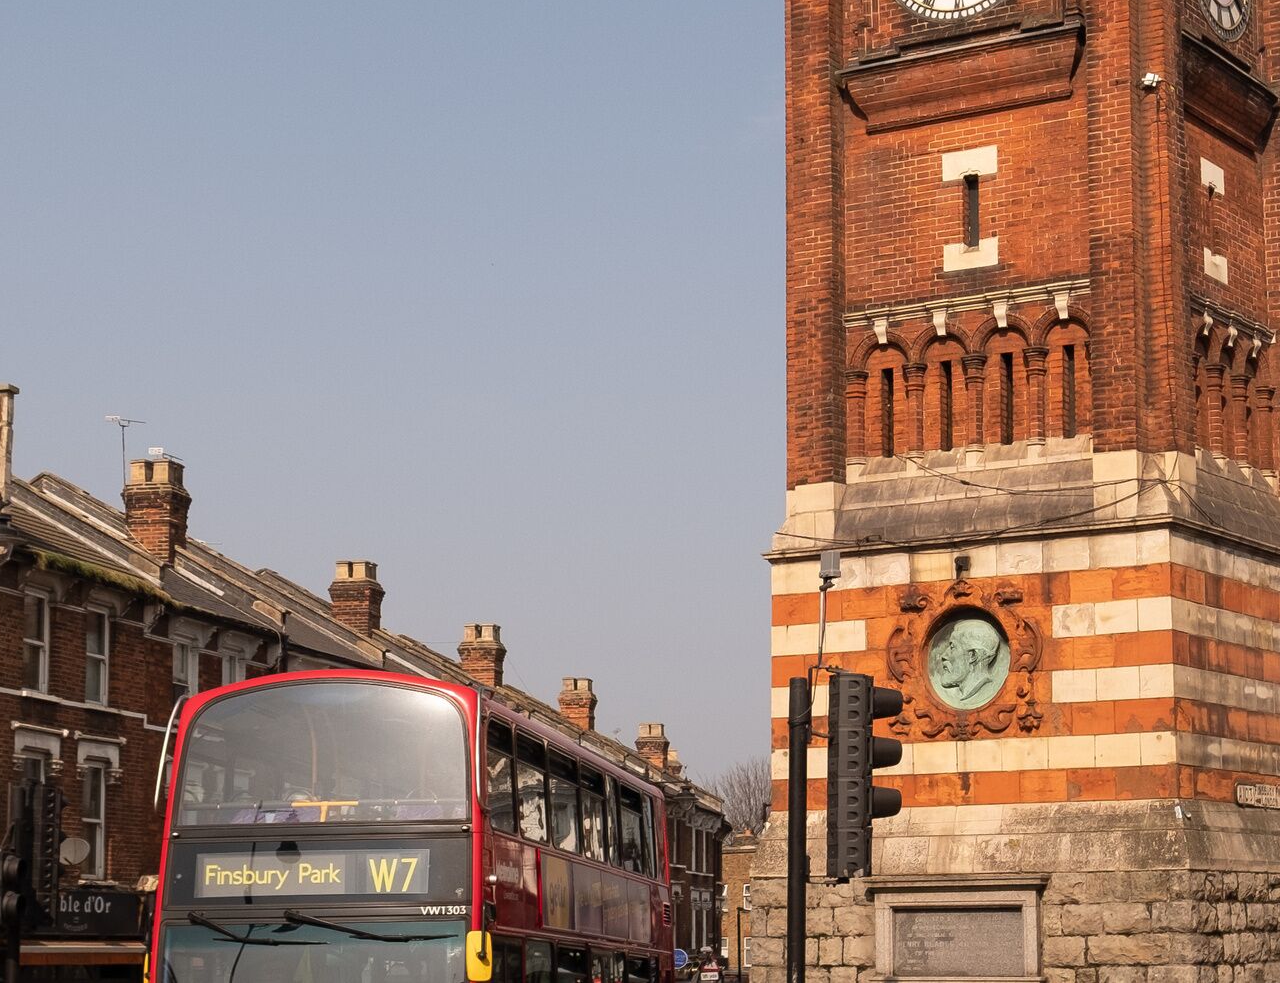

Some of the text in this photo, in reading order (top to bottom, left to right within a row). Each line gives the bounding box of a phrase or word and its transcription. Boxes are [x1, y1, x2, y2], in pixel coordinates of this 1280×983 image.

[205, 862, 341, 890] Finsbury Park
[369, 858, 419, 893] W7
[84, 896, 111, 913] d'Or
[421, 905, 467, 915] VW1303
